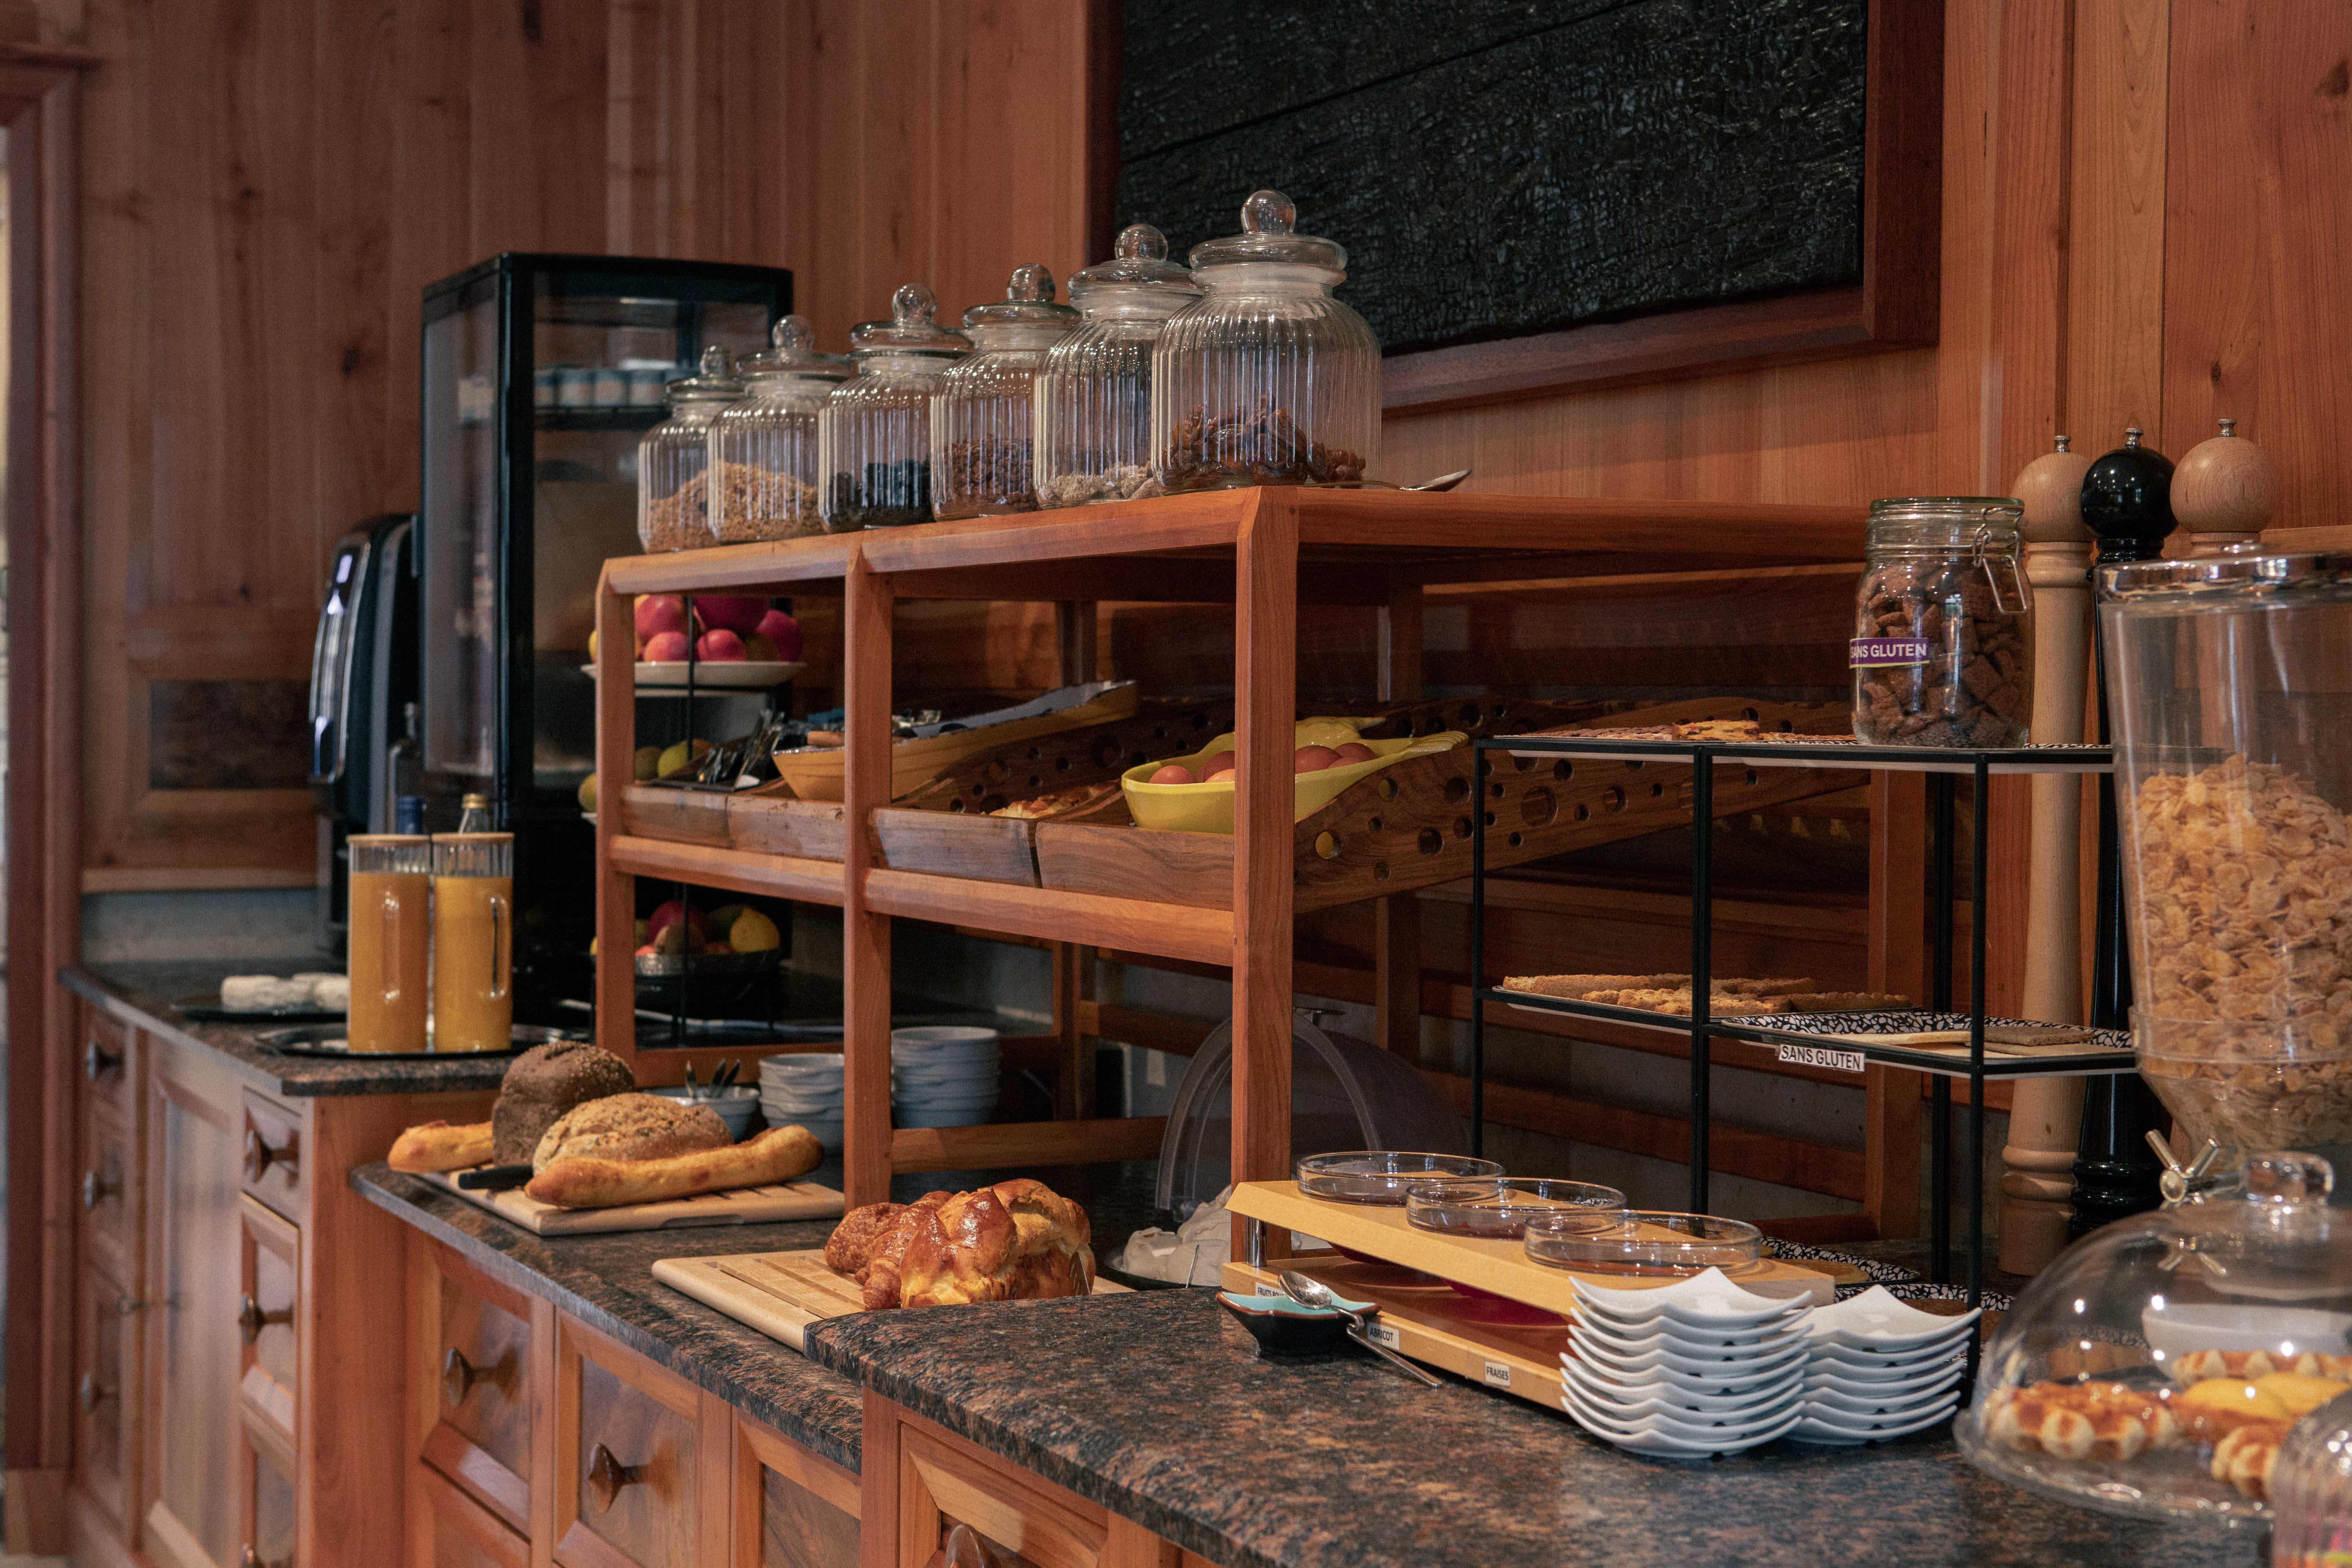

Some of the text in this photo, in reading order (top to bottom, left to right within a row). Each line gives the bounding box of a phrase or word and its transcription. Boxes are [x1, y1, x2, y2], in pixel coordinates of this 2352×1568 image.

[1850, 643, 1927, 658] SANS GLUTEN
[1781, 1045, 1860, 1070] SANS GLUTEN
[1258, 1287, 1272, 1297] FRUITS
[1370, 1327, 1393, 1342] ABRICOT
[1486, 1366, 1508, 1381] FRAISES
